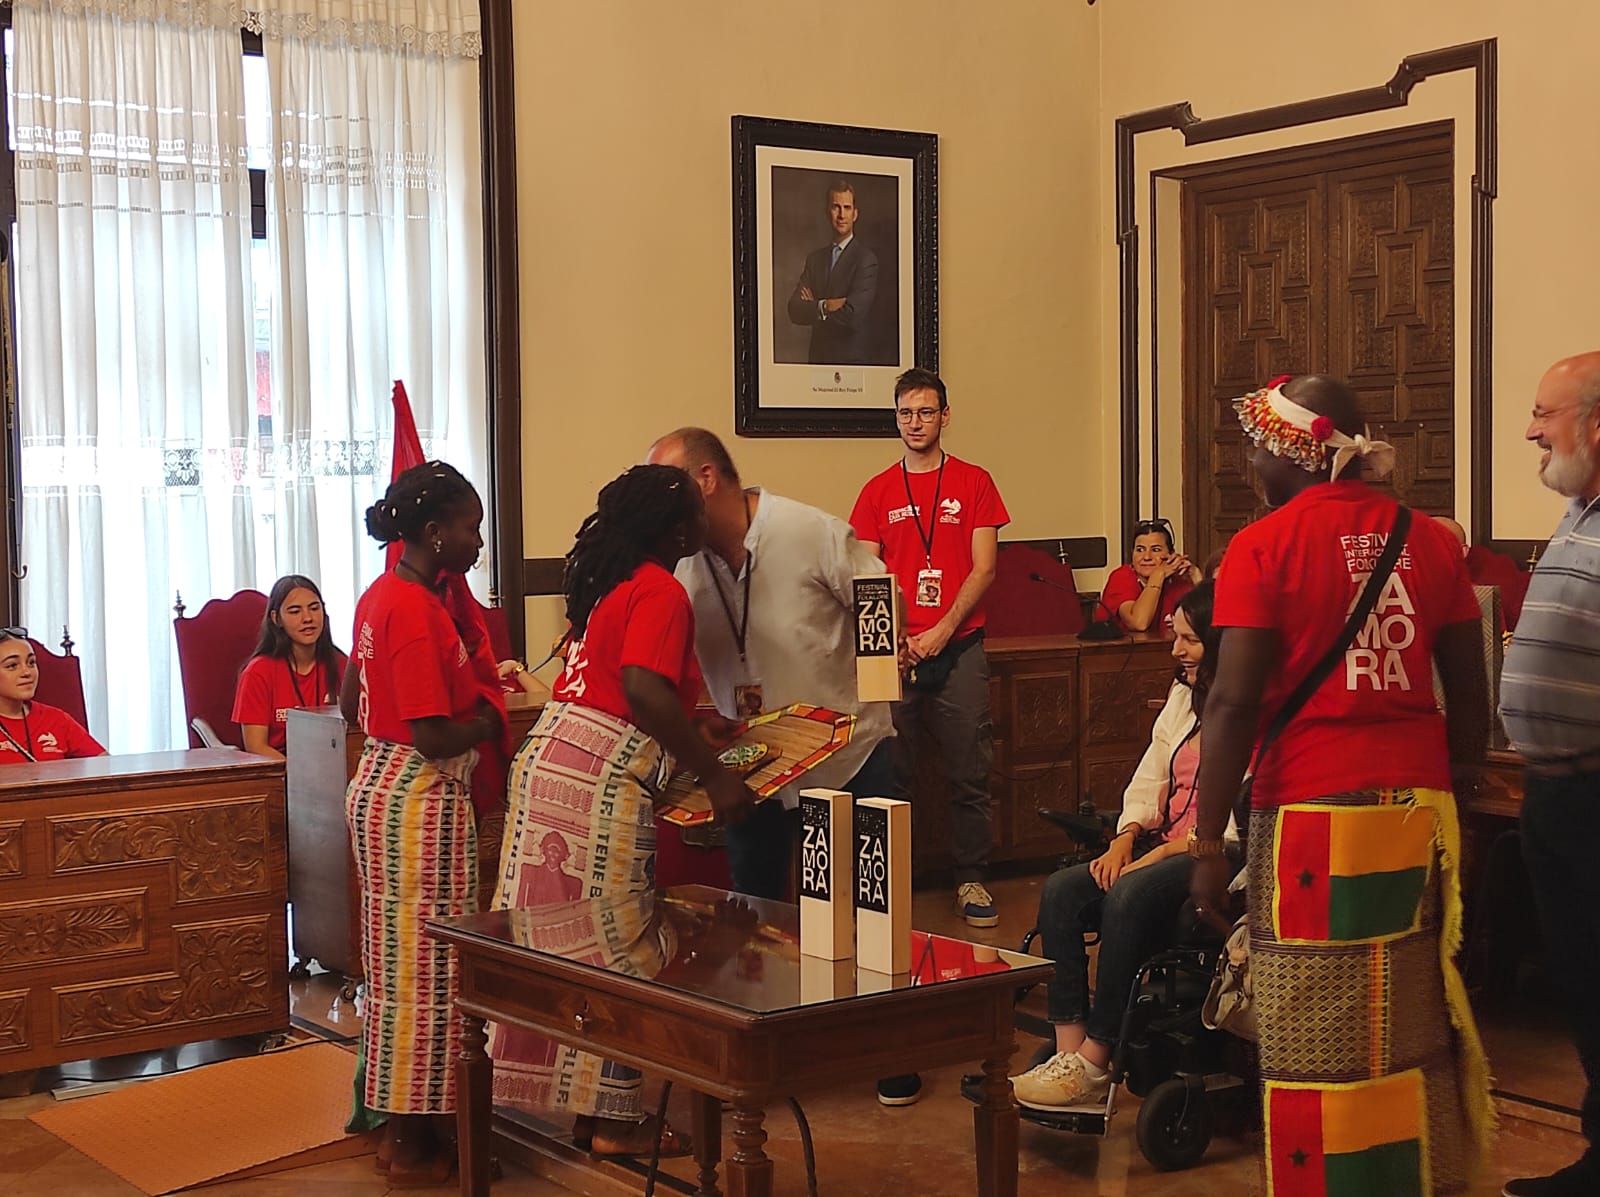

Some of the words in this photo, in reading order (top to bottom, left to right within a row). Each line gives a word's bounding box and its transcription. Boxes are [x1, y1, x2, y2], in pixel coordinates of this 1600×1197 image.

[859, 600, 891, 619] ZA
[859, 618, 892, 634] MO
[860, 633, 892, 652] RA
[1345, 649, 1412, 691] RA
[802, 825, 828, 852] ZA
[859, 834, 885, 862] ZA
[802, 848, 828, 871] MO
[859, 858, 885, 881] MO
[802, 867, 828, 894] RA
[859, 878, 885, 906] RA
